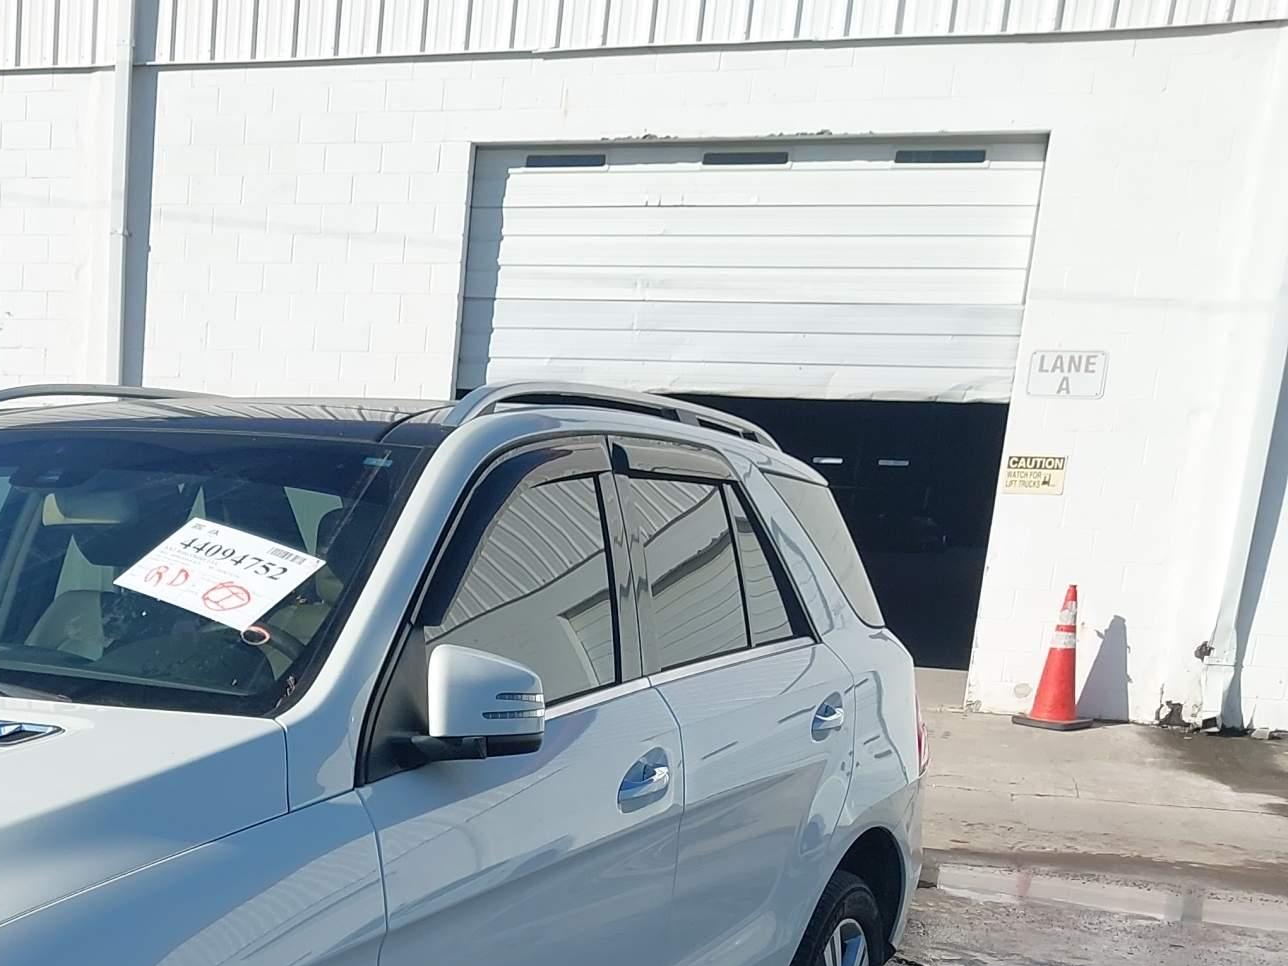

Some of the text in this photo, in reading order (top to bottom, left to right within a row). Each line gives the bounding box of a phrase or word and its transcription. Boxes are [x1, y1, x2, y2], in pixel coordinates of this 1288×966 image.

[1038, 354, 1099, 373] LANE
[1056, 376, 1070, 394] A
[1009, 457, 1064, 469] CAUTION
[1007, 471, 1042, 479] WATCH FOR
[1005, 480, 1041, 488] LIFT TRUCKS
[180, 537, 289, 581] 44094752
